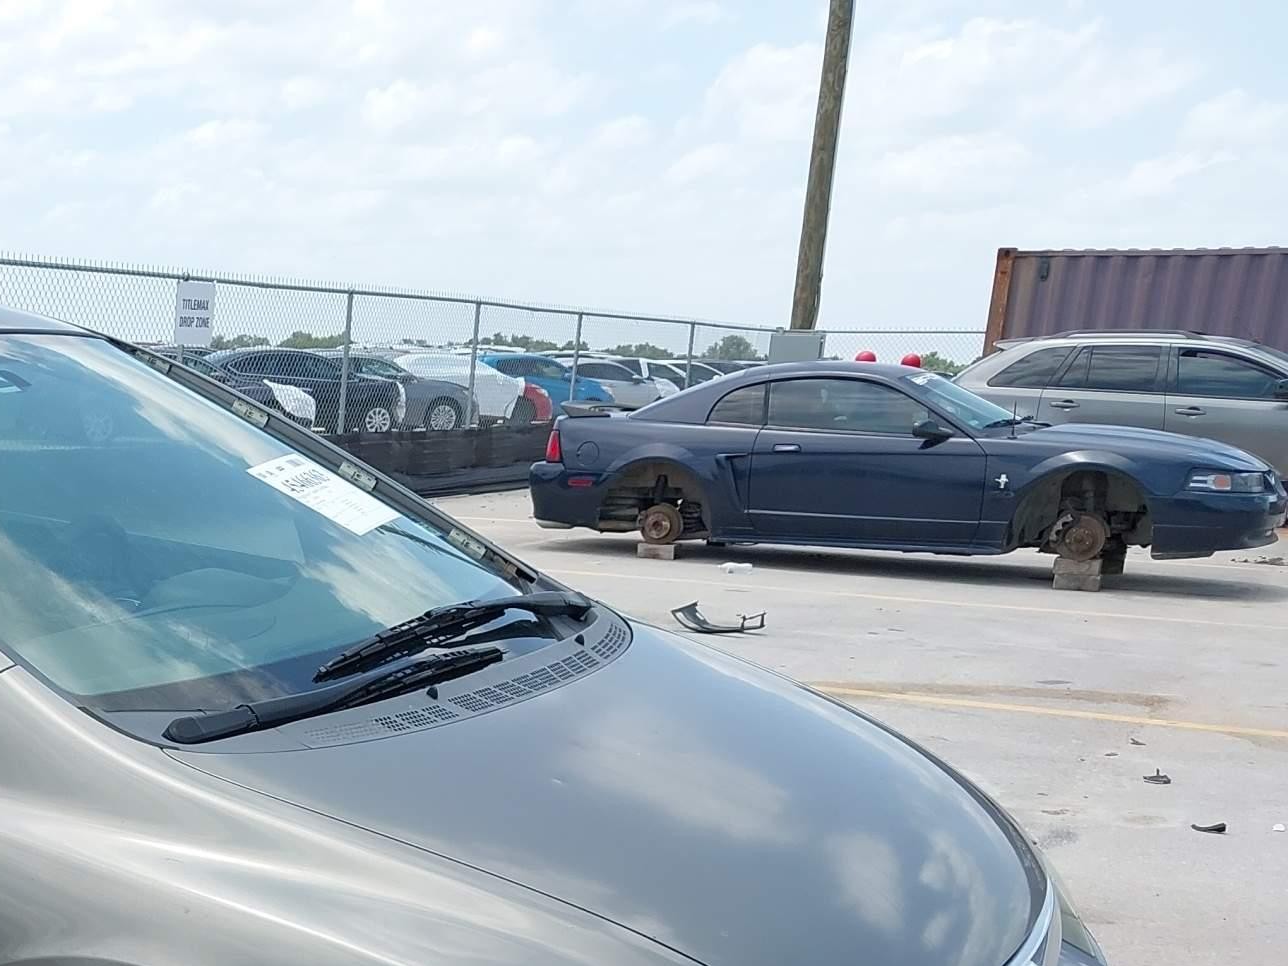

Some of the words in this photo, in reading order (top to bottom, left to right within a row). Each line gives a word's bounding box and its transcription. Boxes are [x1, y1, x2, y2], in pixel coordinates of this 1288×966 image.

[182, 298, 210, 311] TITLEMAX
[179, 316, 195, 328] DROP
[195, 316, 210, 328] ZONE
